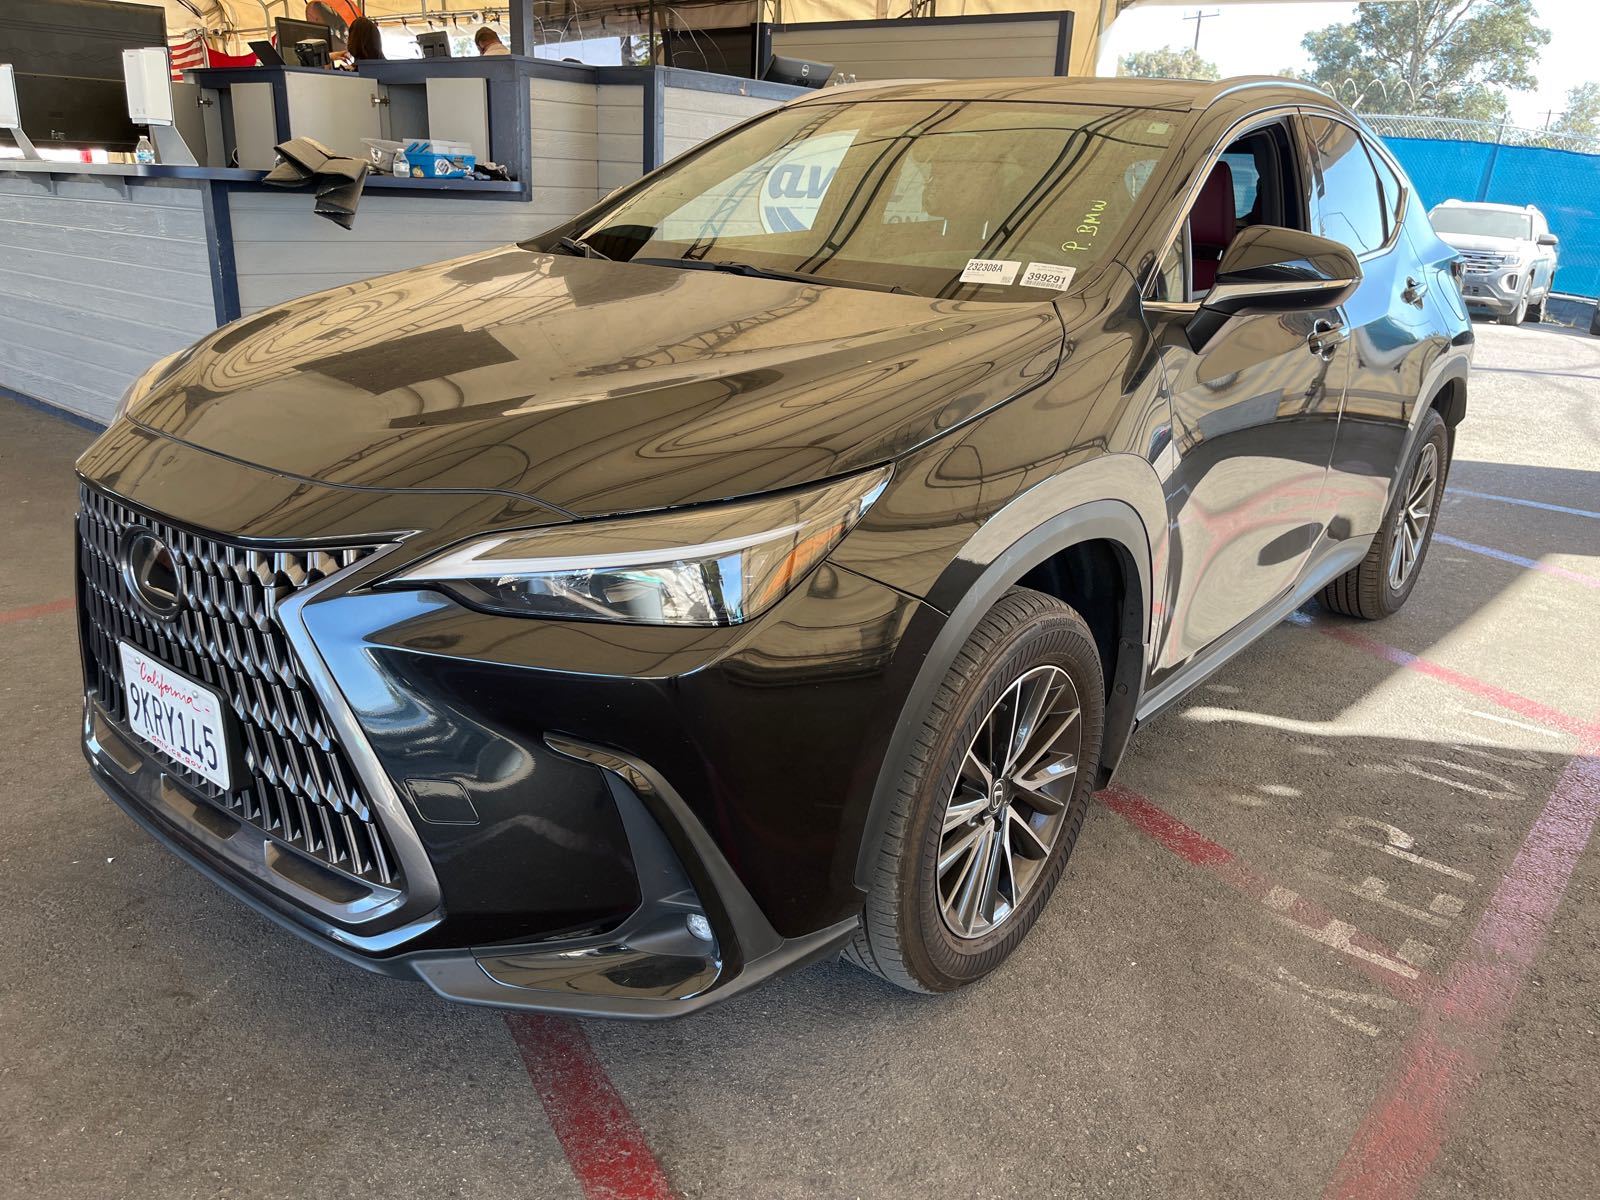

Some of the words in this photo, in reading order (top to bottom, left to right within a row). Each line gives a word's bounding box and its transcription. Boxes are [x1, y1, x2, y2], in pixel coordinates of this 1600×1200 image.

[1076, 200, 1107, 236] BMW
[966, 262, 1004, 273] 232308A
[1027, 272, 1067, 285] 399291
[140, 661, 201, 712] California
[130, 682, 218, 771] 9KRY145
